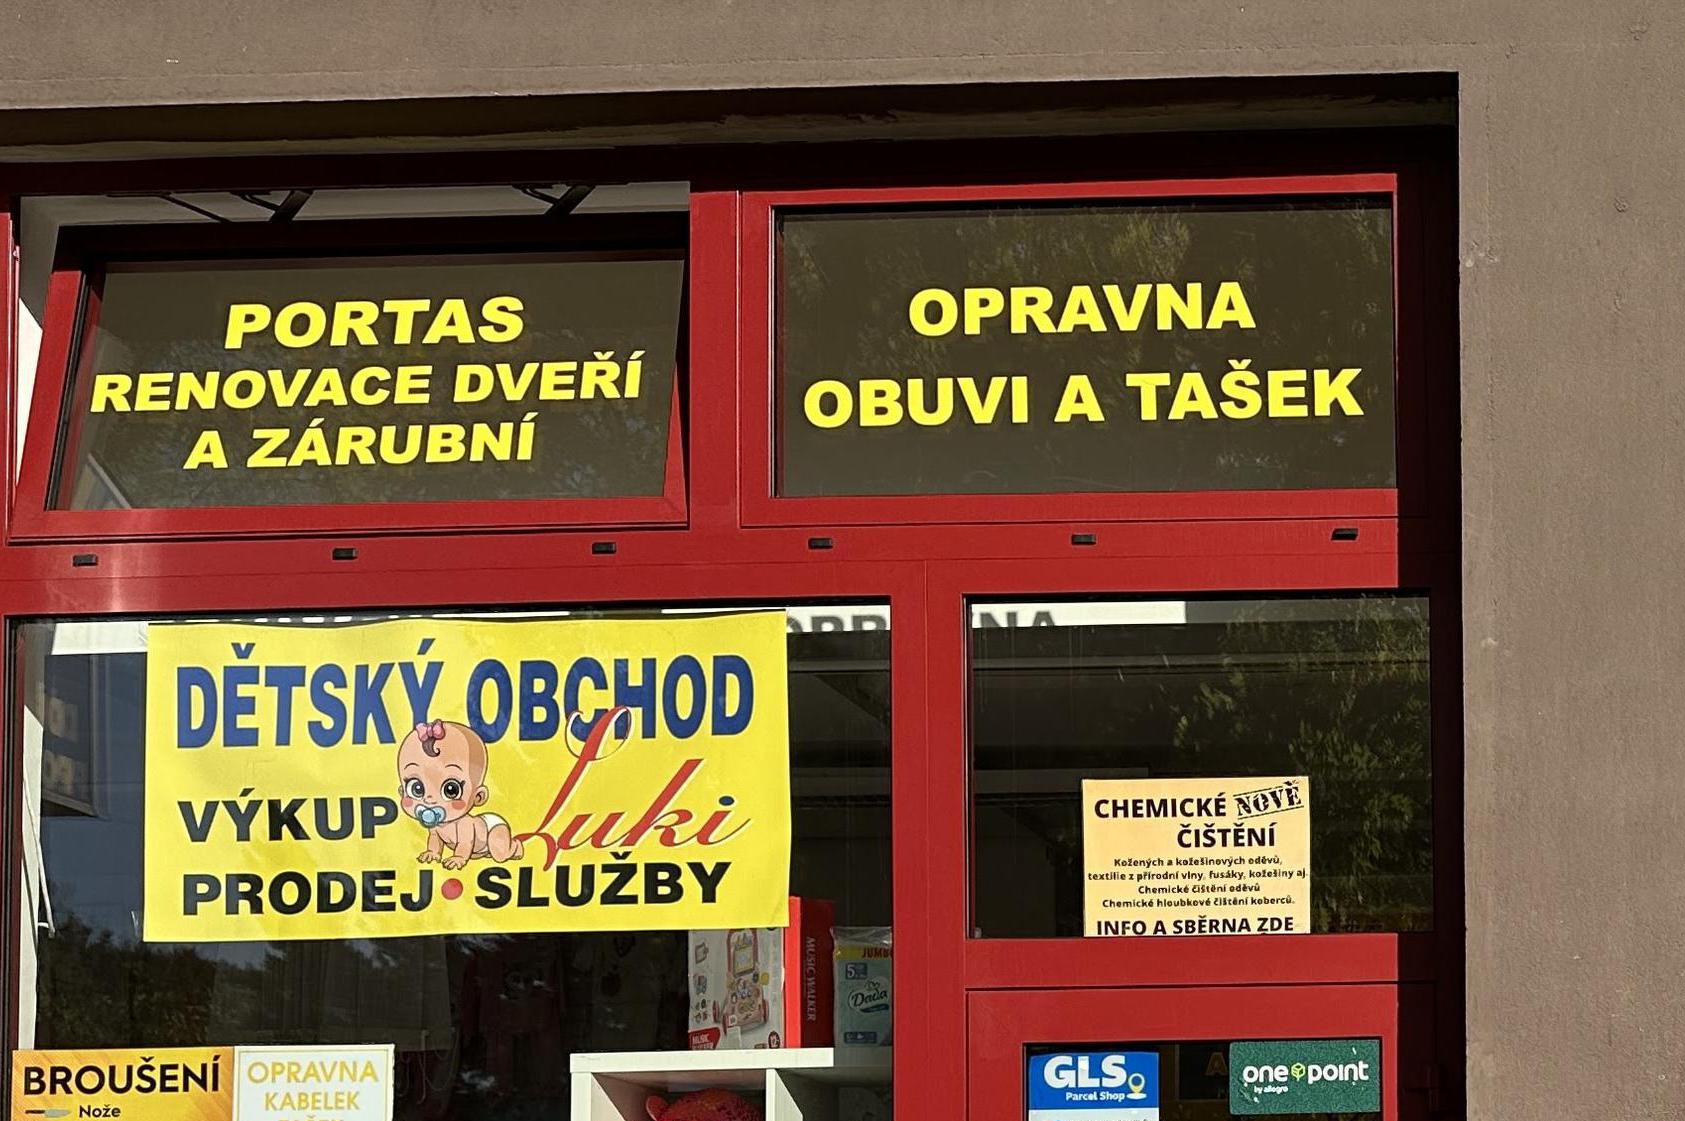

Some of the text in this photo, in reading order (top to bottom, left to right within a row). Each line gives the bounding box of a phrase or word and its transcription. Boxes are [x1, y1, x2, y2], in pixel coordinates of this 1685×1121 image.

[908, 281, 1256, 336] OPRAVNA
[223, 295, 524, 349] PORTAS
[90, 350, 646, 412] RENOVACE DVEŘÍ
[803, 358, 1365, 429] OBUVI A TAŠEK
[183, 412, 538, 469] A ZÁRUBNÍ
[177, 638, 755, 748] DĚTSKÝ OBCHOD
[178, 787, 399, 843] VÝKUP
[1094, 793, 1227, 819] CHEMICKÉ
[1177, 822, 1276, 849] ČIŠTĚNÍ
[1114, 855, 1283, 868] Kožených a kožešinových oděvů,
[183, 852, 732, 917] PRODEJ SLUŽBY
[1087, 869, 1126, 881] textilie
[1128, 872, 1134, 881] z
[1136, 870, 1179, 883] přírodní
[1249, 868, 1293, 880] kožešiny
[1138, 881, 1260, 895] Chemické čištění oděvů
[1102, 896, 1154, 908] Chemické
[1156, 896, 1211, 908] hloubkové
[1213, 895, 1248, 906] čištění
[1096, 914, 1294, 936] INFO A SBĚRNA ZDE
[24, 1055, 221, 1096] BROUŠENÍ
[247, 1060, 379, 1085] OPRAVNA
[1043, 1054, 1127, 1089] GLS
[1243, 1060, 1369, 1086] one point
[264, 1091, 360, 1111] KABELEK
[1066, 1090, 1125, 1103] Parcel Shop
[79, 1104, 121, 1118] Nože
